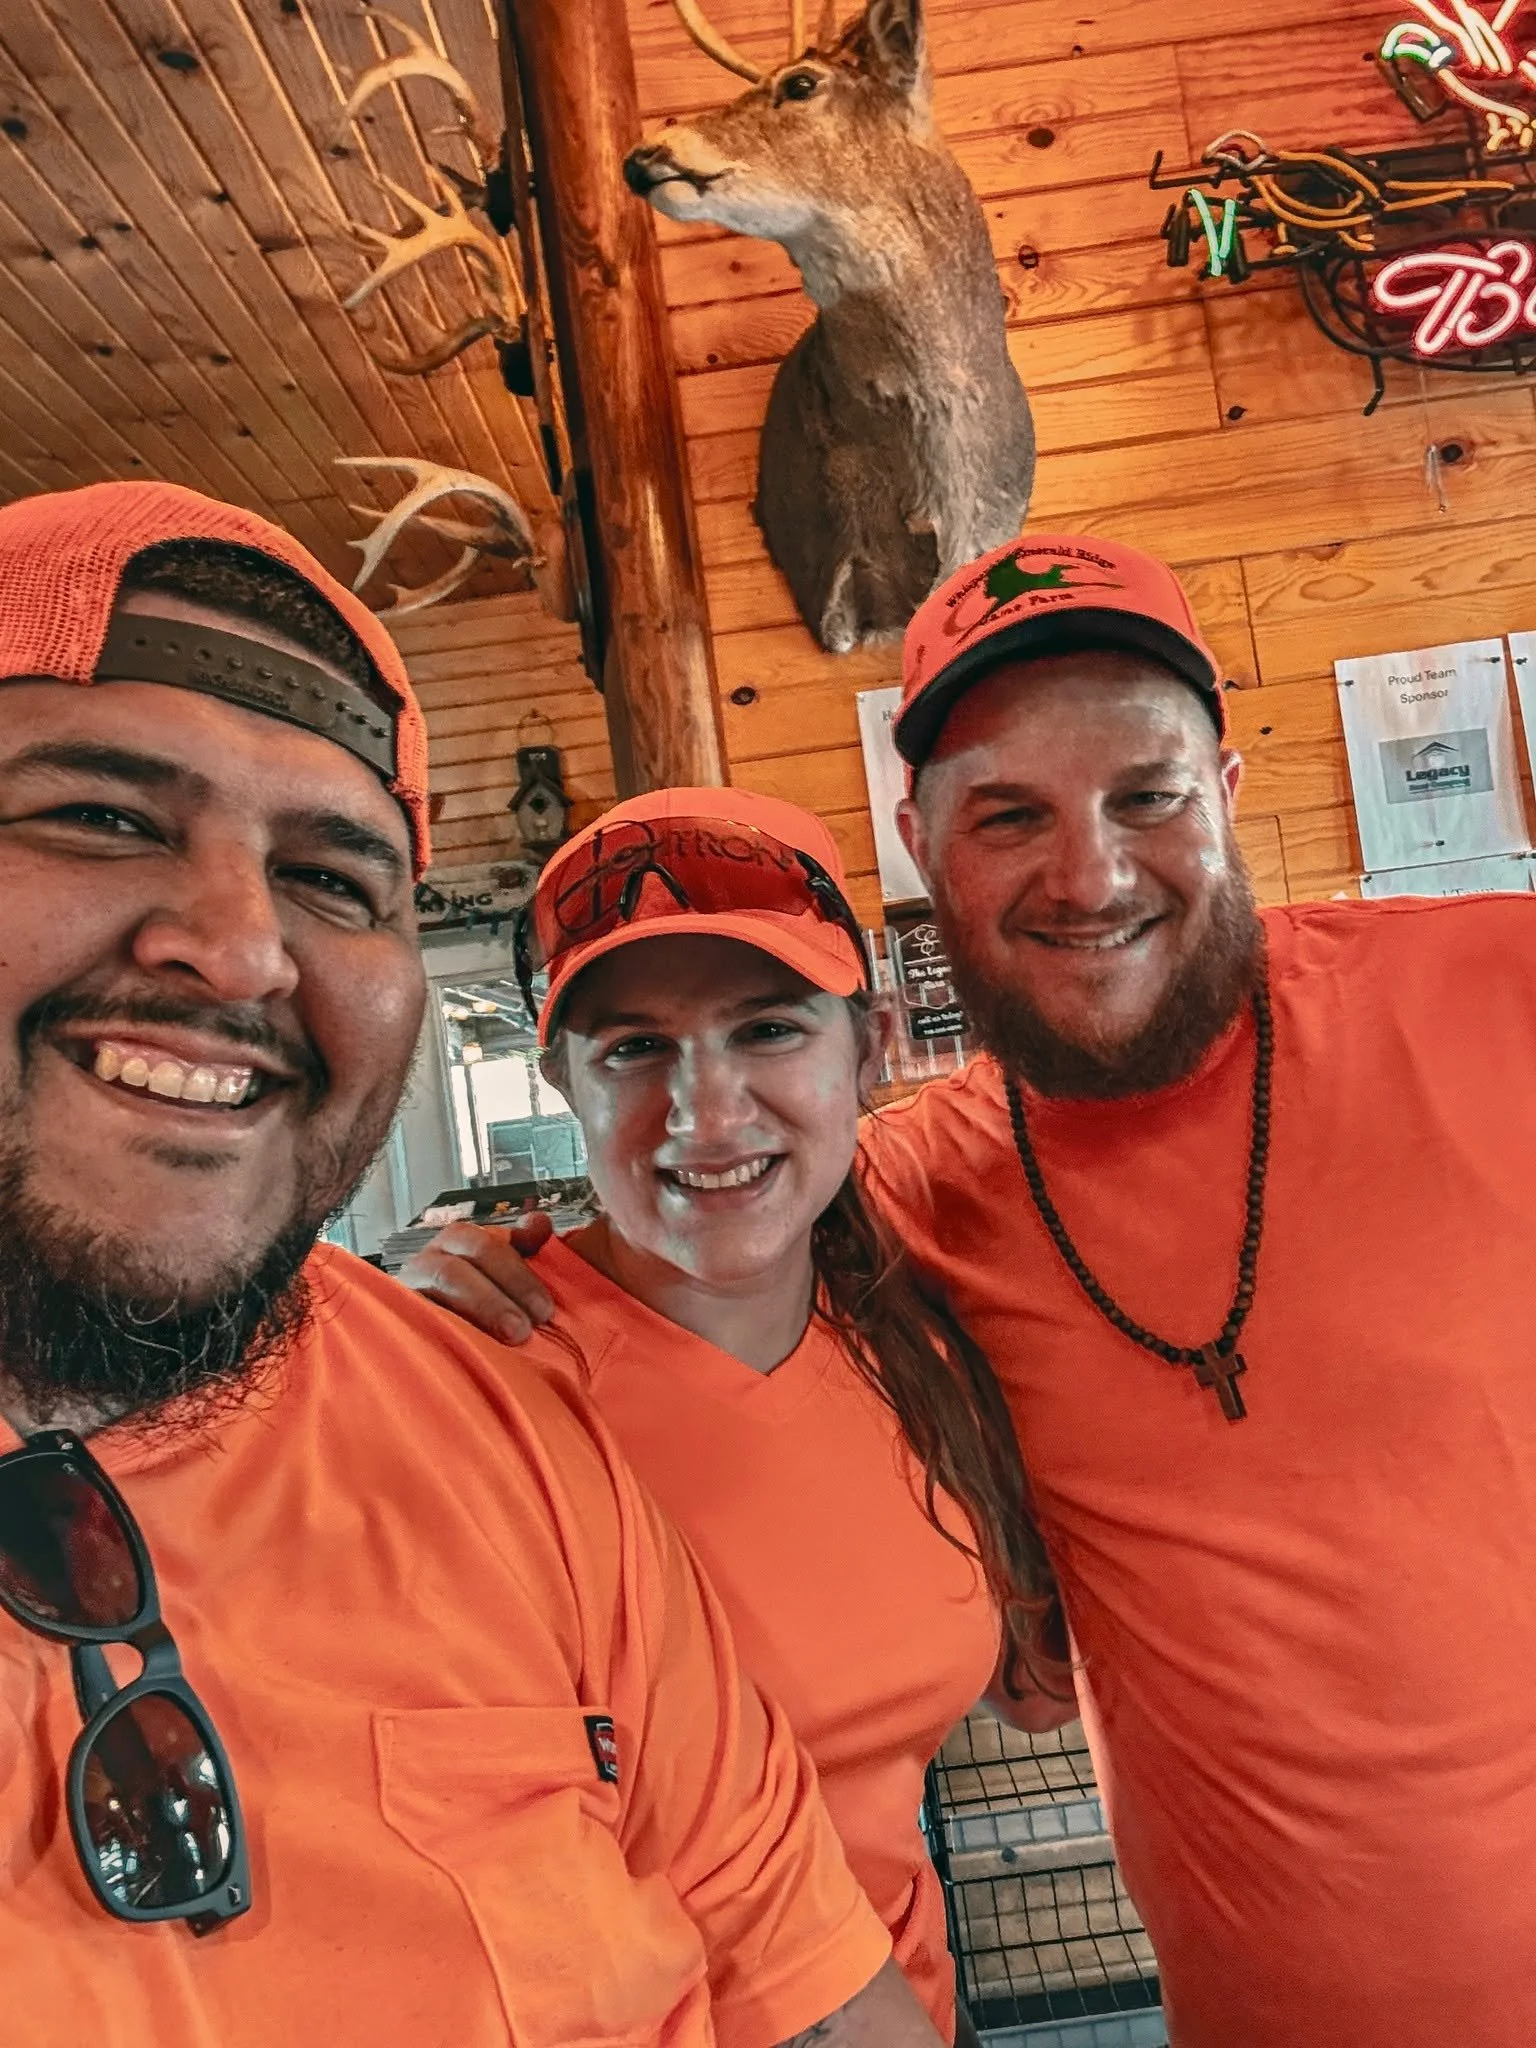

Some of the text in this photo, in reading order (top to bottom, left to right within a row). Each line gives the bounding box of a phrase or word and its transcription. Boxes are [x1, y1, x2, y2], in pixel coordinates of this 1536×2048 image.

[1387, 668, 1457, 686] Proud Team
[1400, 689, 1449, 705] Sponsor
[1405, 764, 1470, 782] Legacy
